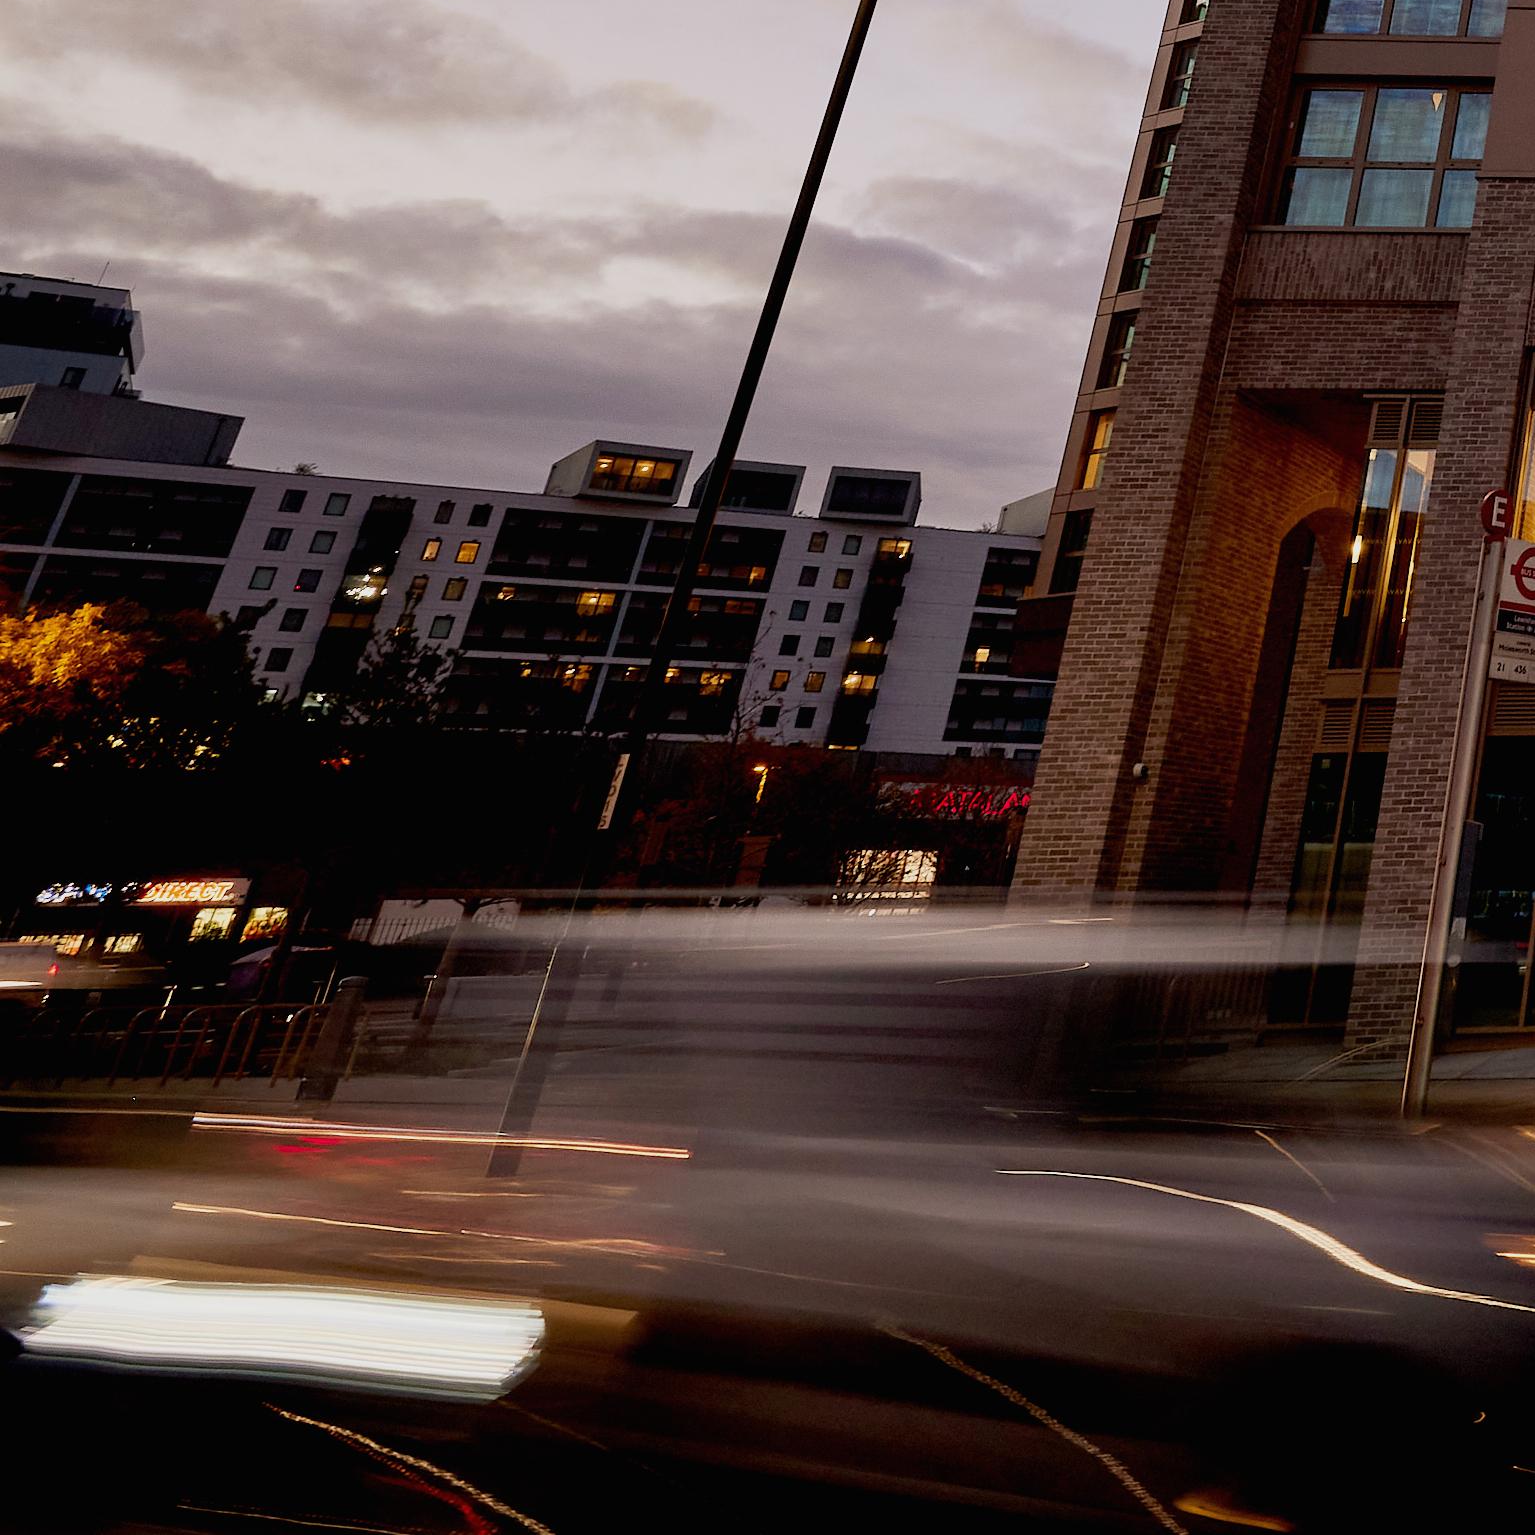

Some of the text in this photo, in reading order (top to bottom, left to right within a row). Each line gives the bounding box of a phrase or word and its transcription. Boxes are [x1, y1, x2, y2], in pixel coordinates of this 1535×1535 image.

[1491, 496, 1508, 528] E
[1520, 567, 1532, 577] BUS
[1497, 662, 1527, 675] 21 436
